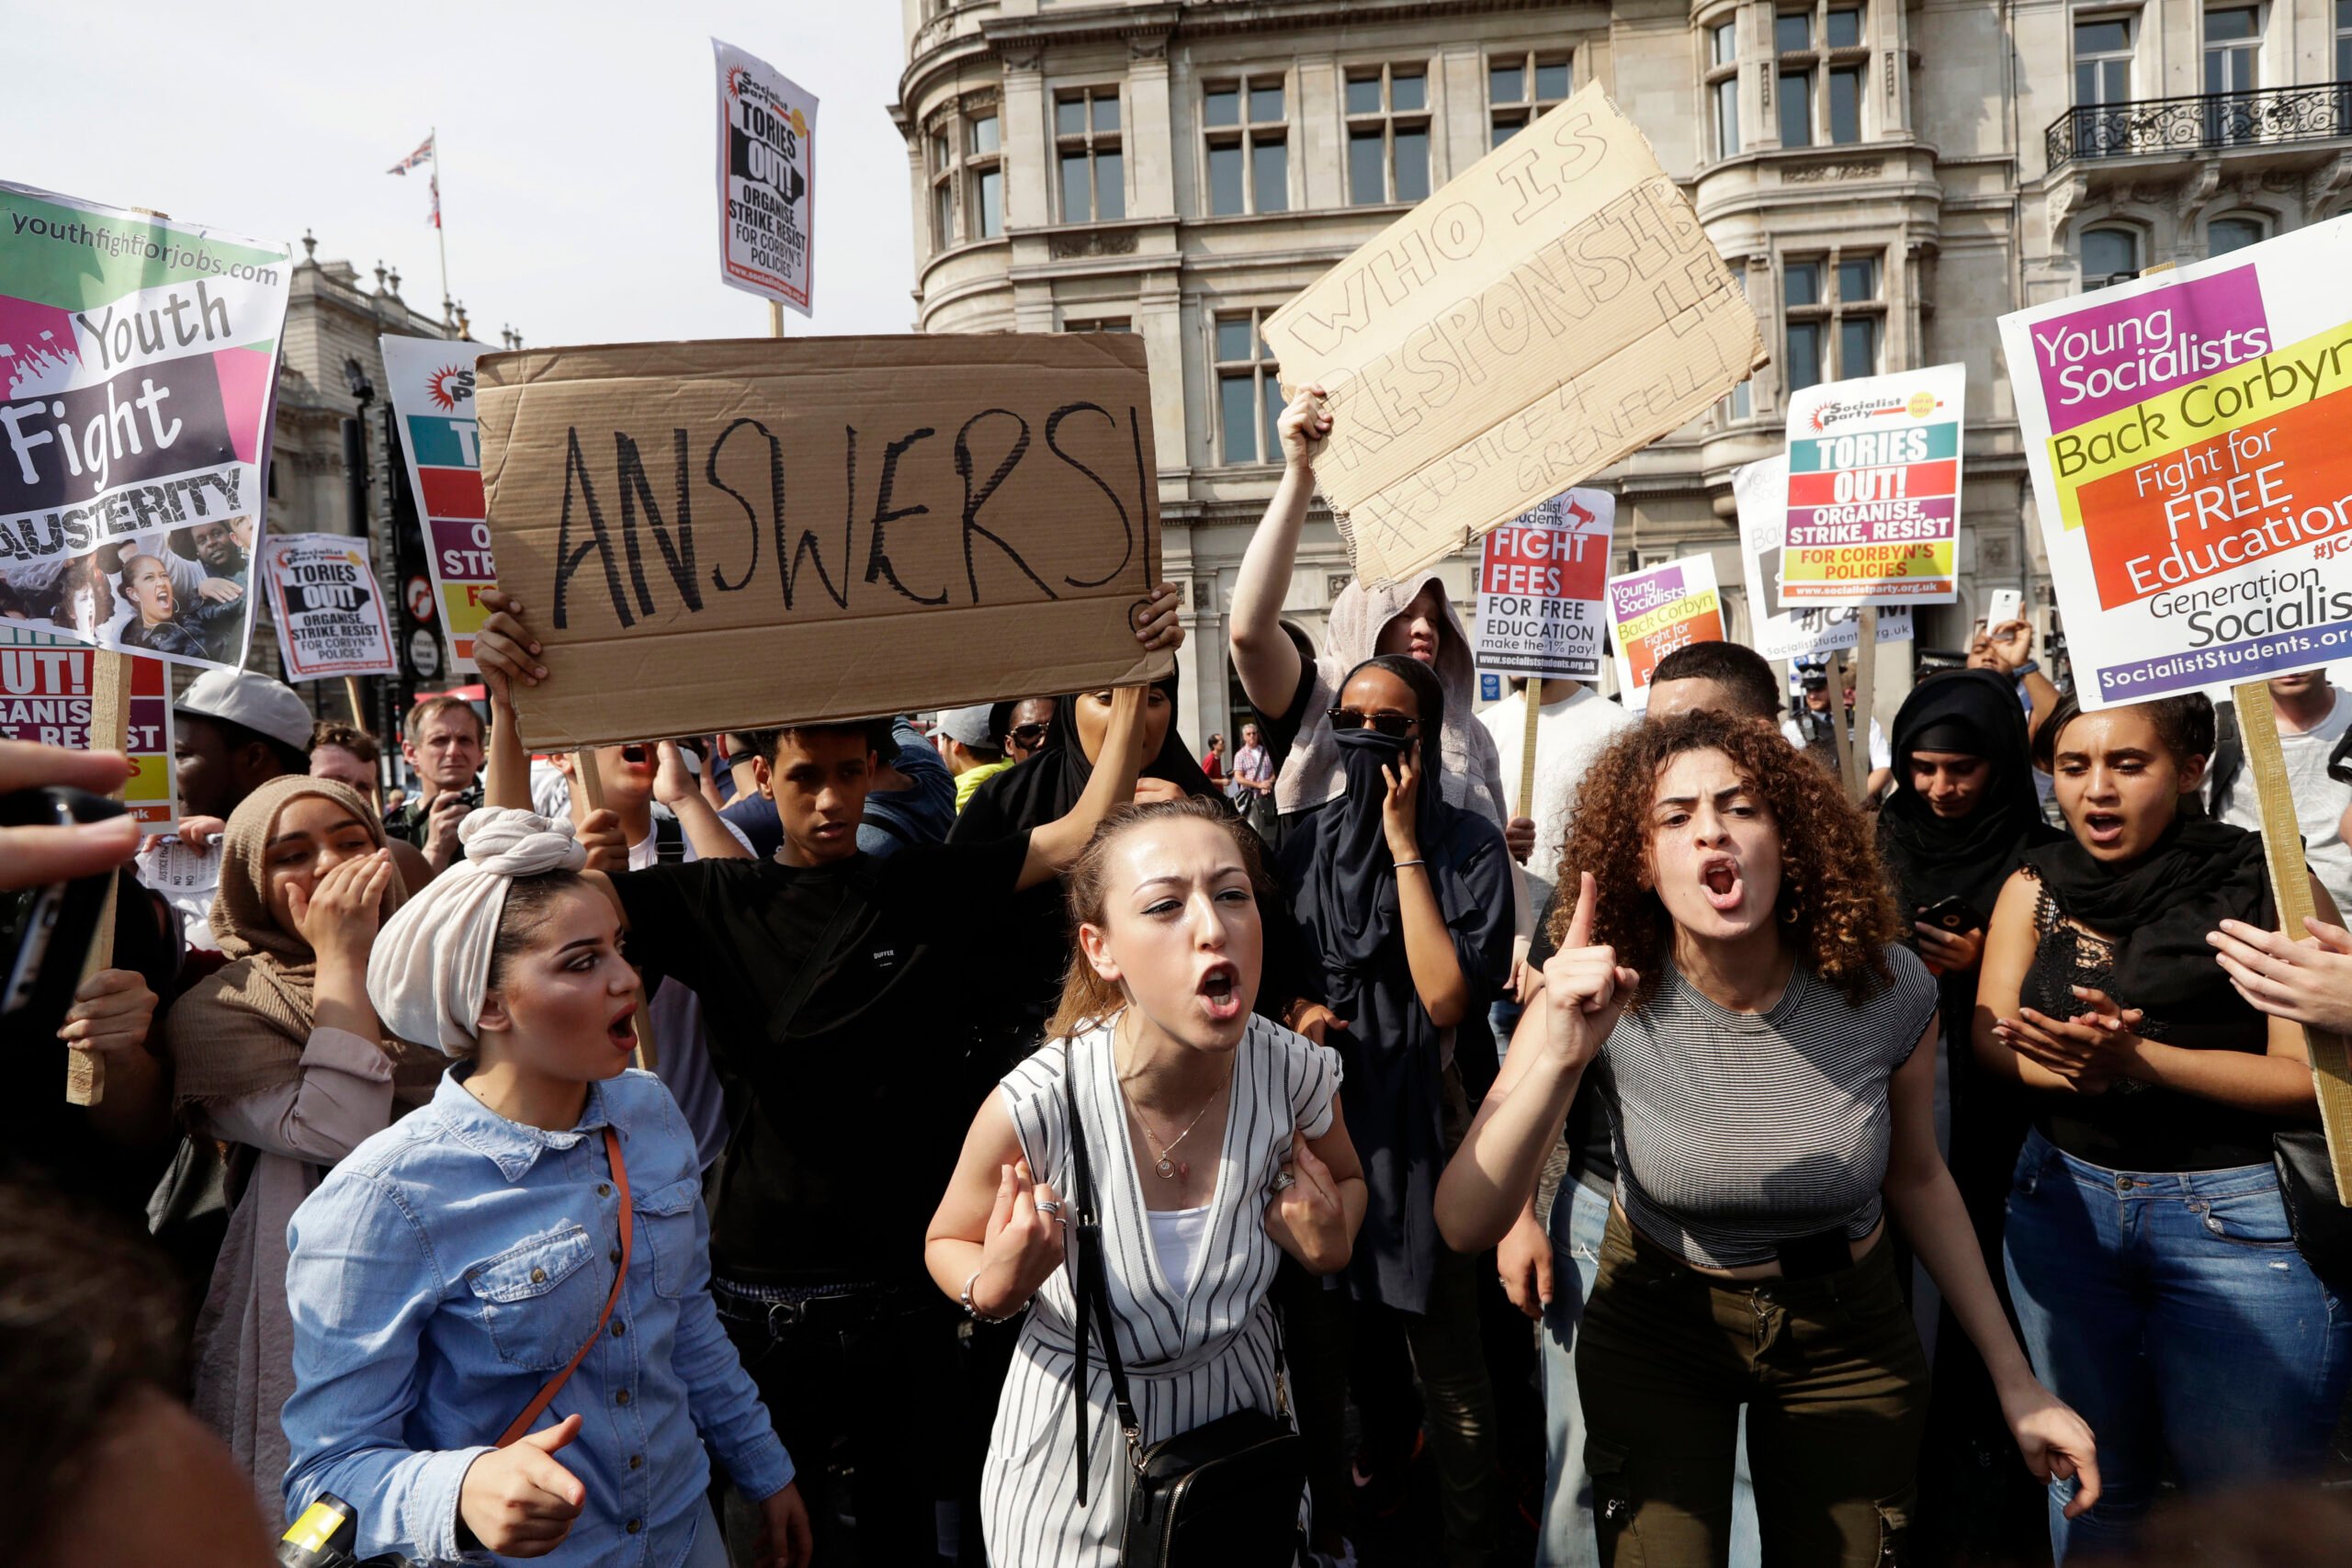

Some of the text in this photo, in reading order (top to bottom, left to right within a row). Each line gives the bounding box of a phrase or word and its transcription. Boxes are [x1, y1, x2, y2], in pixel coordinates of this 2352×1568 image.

[738, 82, 775, 109] Party
[741, 99, 796, 159] TORIES
[748, 141, 792, 198] OUT!
[11, 212, 278, 287] youthfightforjobs.com
[737, 223, 801, 267] FOR CORBYN'S
[776, 219, 806, 252] RESIST
[1287, 113, 1608, 356] WHO IS
[752, 247, 791, 278] POLICIES
[76, 280, 232, 370] Youth
[2036, 308, 2173, 367] Young
[2059, 327, 2268, 405] Socialists
[1517, 332, 1734, 493] GRENFELL!
[1824, 410, 1872, 425] Party
[1830, 398, 1902, 414] Socialist
[0, 378, 183, 492] Fight
[1816, 428, 1928, 470] TORIES
[2053, 404, 2170, 479] Back
[1367, 376, 1596, 551] #JUSTICE 4
[2134, 427, 2278, 498] Fight for
[1833, 466, 1907, 504] OUT!
[2164, 460, 2293, 540] FREE
[551, 401, 1154, 636] ANSWERS!
[1813, 501, 1927, 525] ORGANISE,
[1494, 528, 1589, 562] FIGHT
[1790, 517, 1951, 545] STRIKE, RESIST
[1801, 544, 1935, 564] FOR CORBYN'S
[2313, 536, 2352, 560] #JC
[290, 564, 356, 583] TORIES
[1491, 563, 1561, 597] FEES
[1825, 562, 1908, 580] POLICIES
[303, 585, 356, 609] OUT!
[1611, 580, 1656, 600] Young
[1619, 587, 1686, 615] Socialists
[1796, 583, 1938, 595] www.socialistparty.org.uk
[2149, 568, 2320, 618] Generation
[1488, 597, 1585, 620] FOR FREE
[1618, 594, 1713, 640] Back Corbyn
[1801, 605, 1907, 634] #JC4M
[301, 638, 322, 650] FOR
[341, 625, 379, 636] RESIST
[1487, 619, 1594, 641] EDUCATION
[1645, 623, 1690, 649] Fight for
[1479, 654, 1595, 671] www.socialiststudents.org.uk
[1481, 637, 1596, 657] make the 1% pay!
[2101, 626, 2352, 688] SocialistStudents.or
[174, 875, 182, 886] NO
[186, 875, 194, 886] NO
